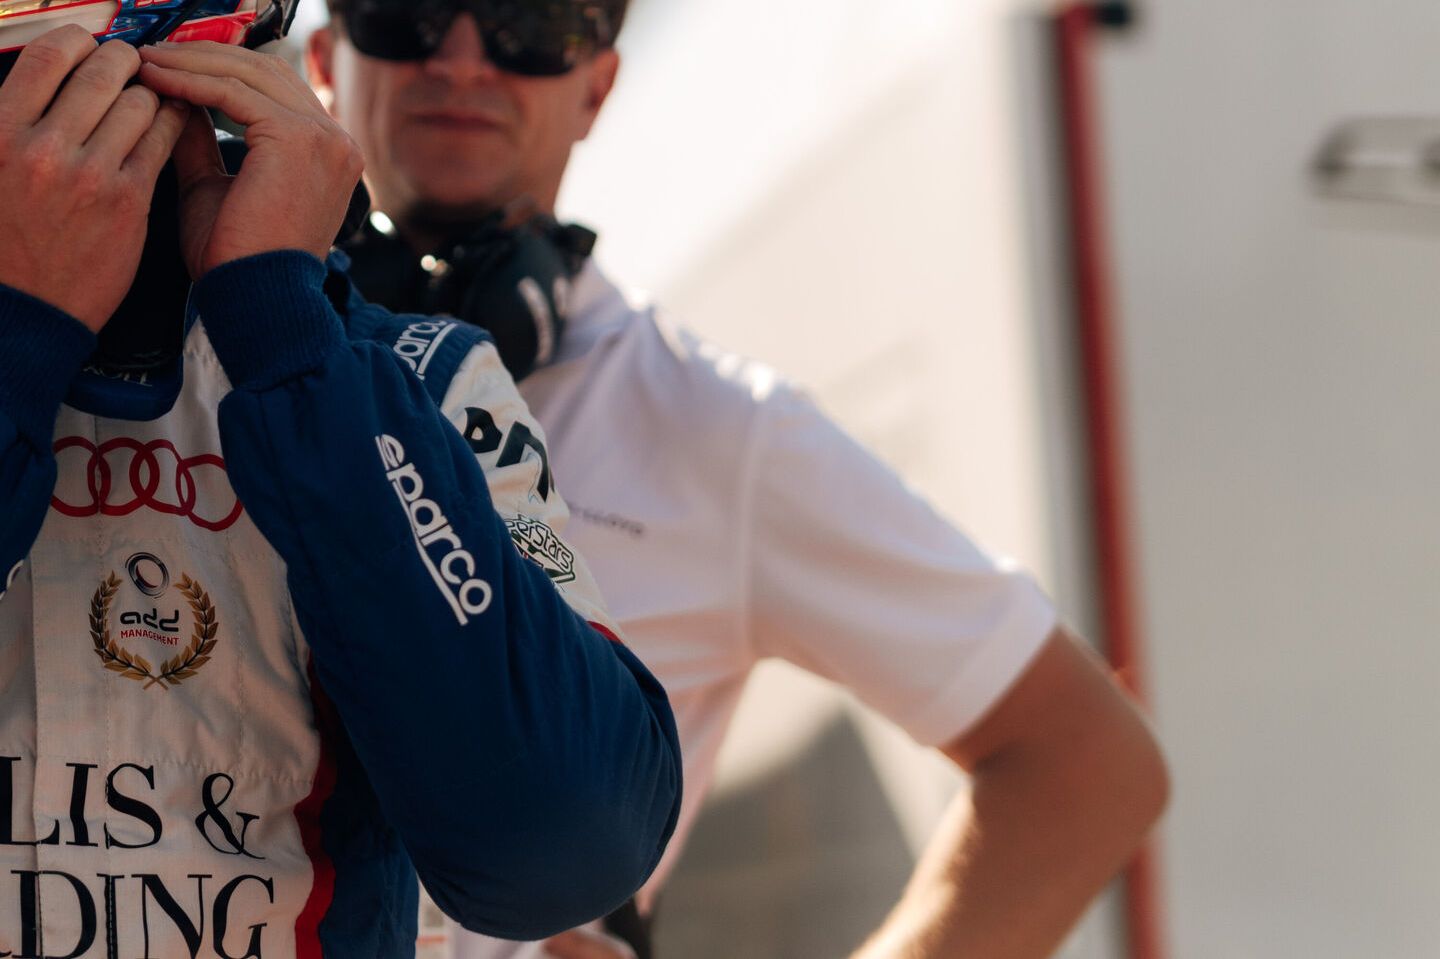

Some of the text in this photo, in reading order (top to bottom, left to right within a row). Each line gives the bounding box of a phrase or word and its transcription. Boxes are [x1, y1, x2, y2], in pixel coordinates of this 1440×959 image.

[375, 433, 492, 621] sparco
[120, 629, 180, 646] MANAGEMENT
[194, 772, 266, 859] &
